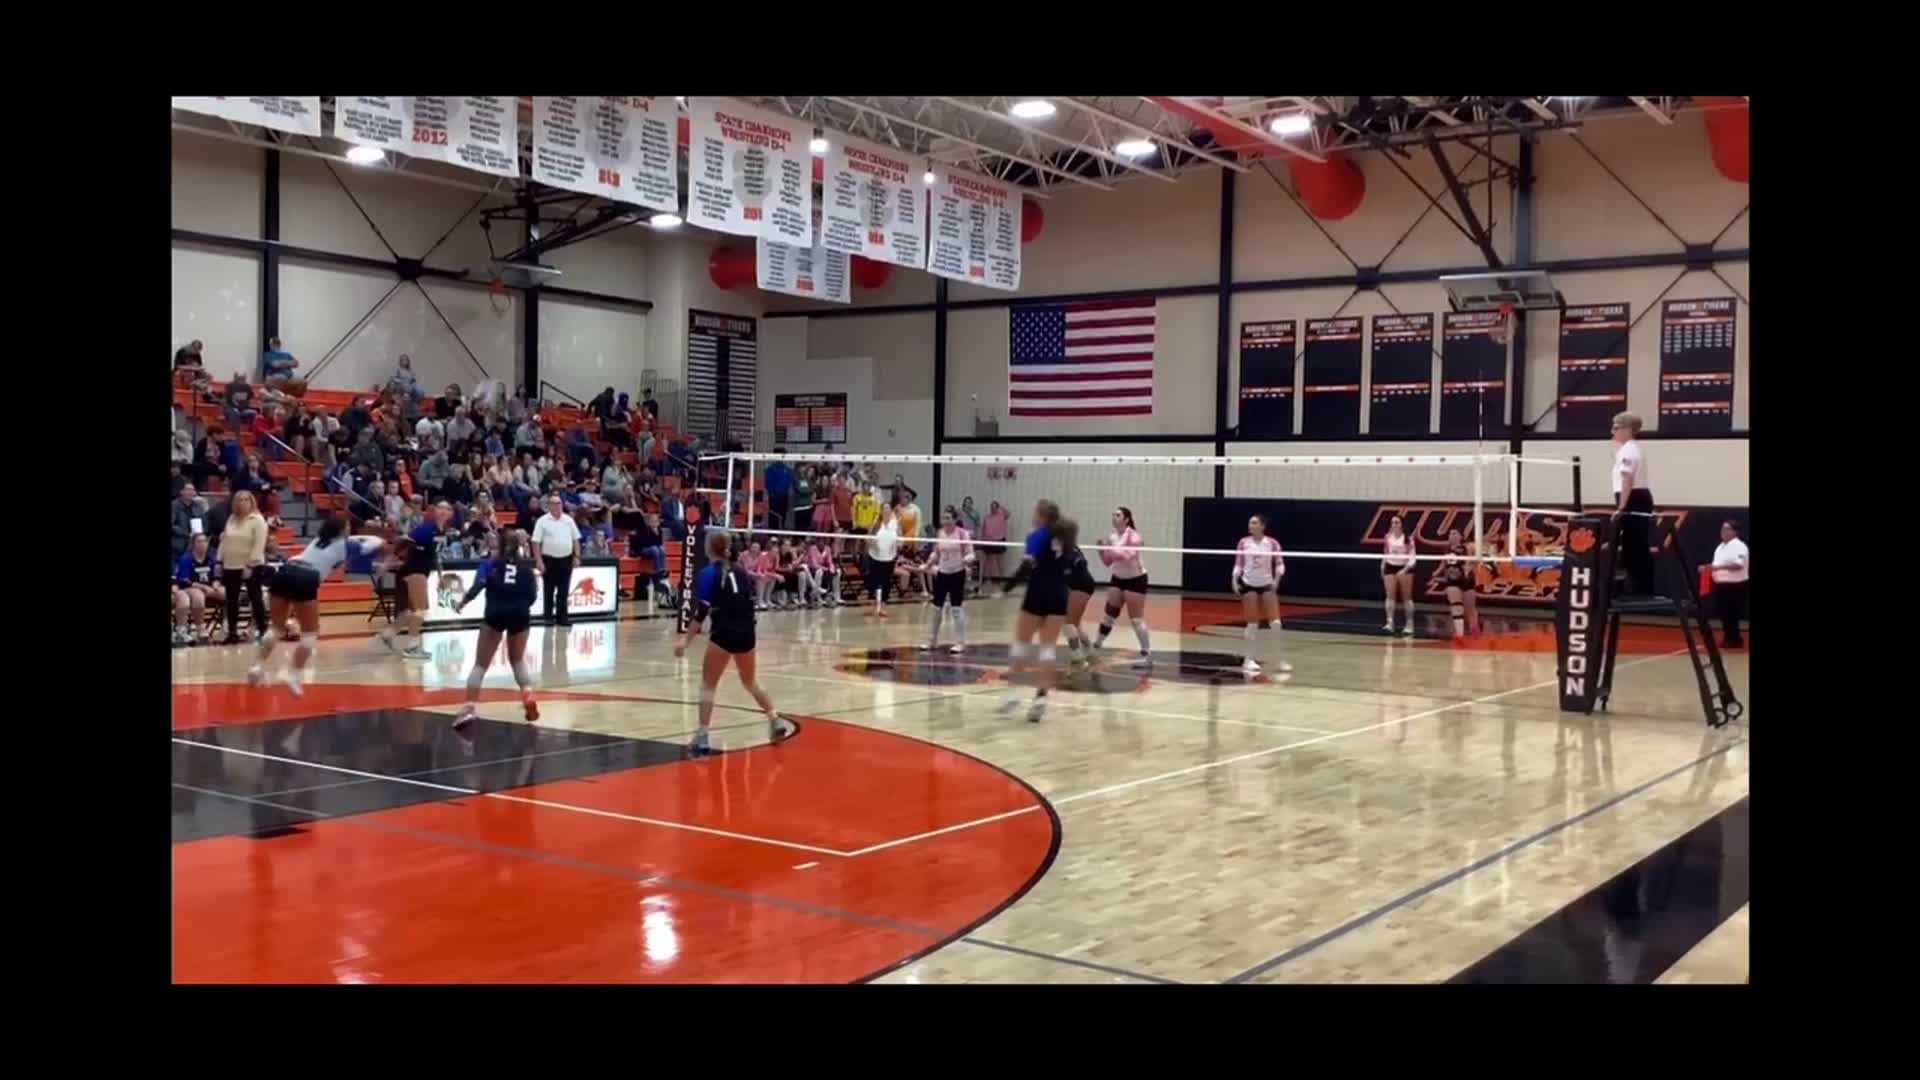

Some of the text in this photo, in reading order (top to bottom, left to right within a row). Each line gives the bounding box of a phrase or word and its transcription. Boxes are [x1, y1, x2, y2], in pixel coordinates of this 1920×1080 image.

[412, 128, 448, 146] 2012
[504, 564, 517, 584] 2
[682, 524, 696, 632] VOLLEYBALL
[729, 571, 739, 593] 1
[1566, 566, 1591, 697] HUDSON
